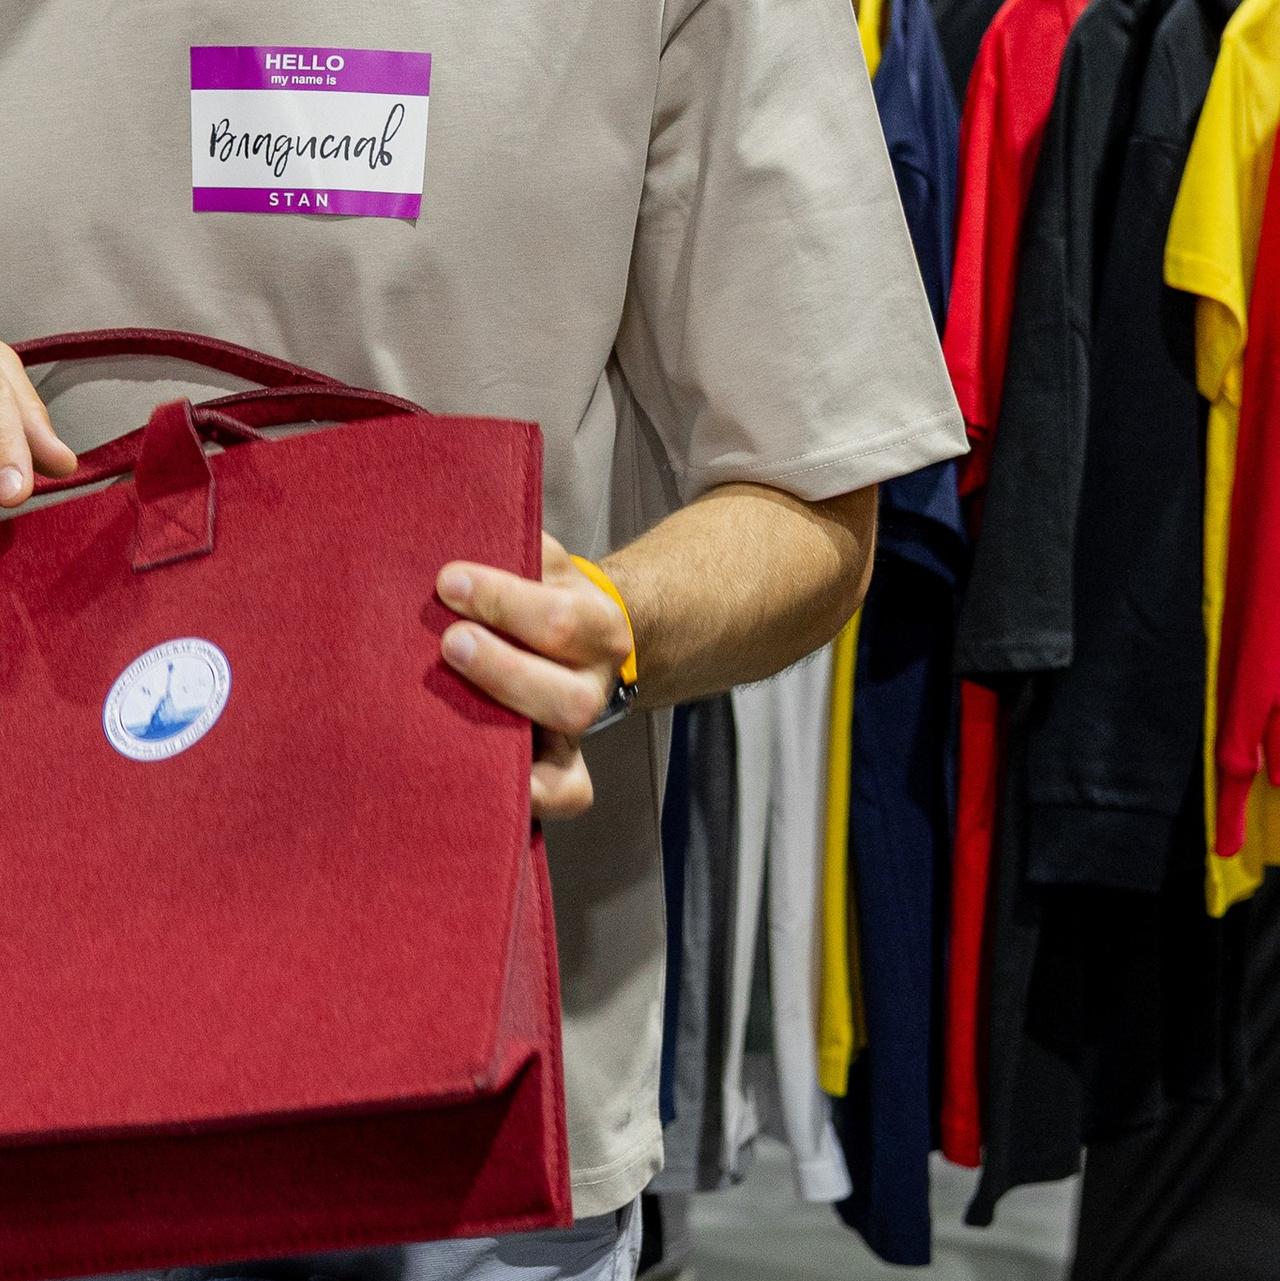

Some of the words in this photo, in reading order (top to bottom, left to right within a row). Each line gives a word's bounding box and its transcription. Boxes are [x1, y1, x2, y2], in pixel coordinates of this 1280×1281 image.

[265, 53, 345, 71] HELLO
[271, 75, 290, 88] my
[291, 74, 323, 85] name
[326, 74, 337, 86] is
[209, 103, 405, 178] Владислав
[269, 192, 329, 207] STAN
